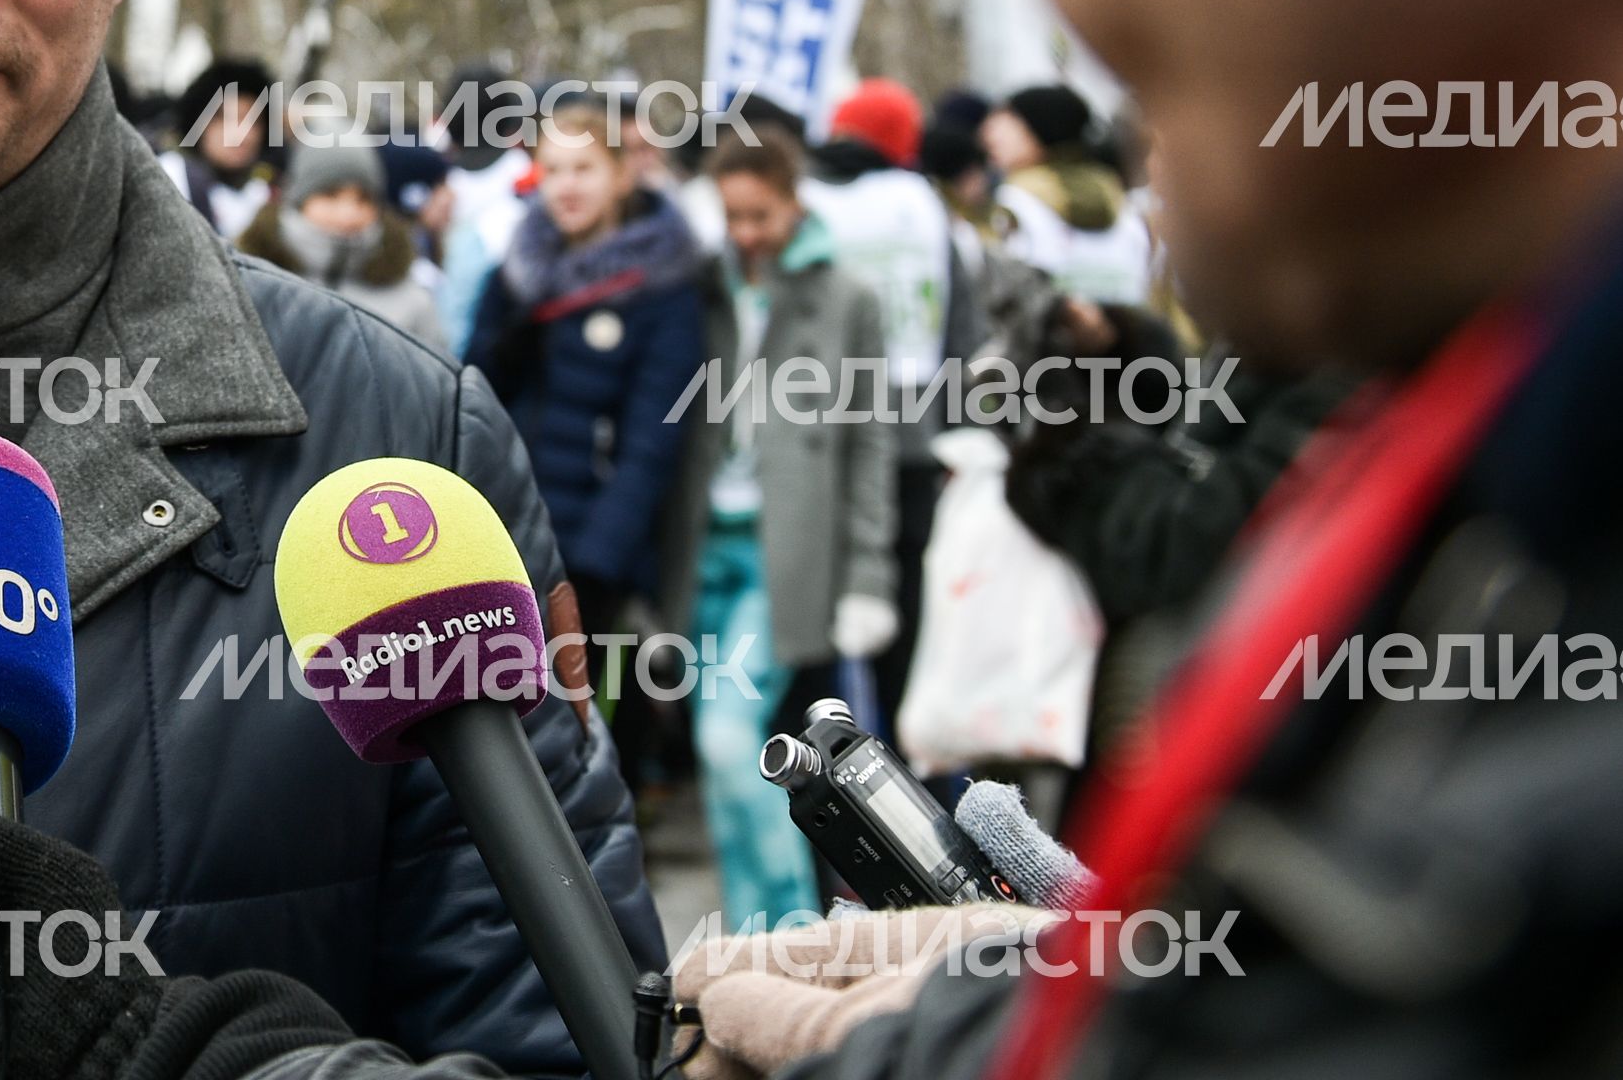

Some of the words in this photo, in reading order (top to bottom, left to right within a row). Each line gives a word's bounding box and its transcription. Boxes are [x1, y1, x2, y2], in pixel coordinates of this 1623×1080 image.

[370, 502, 410, 545] 1
[340, 606, 517, 685] Radio1.news
[827, 802, 841, 816] EAR
[858, 836, 881, 862] REMOTE
[899, 883, 913, 898] USB
